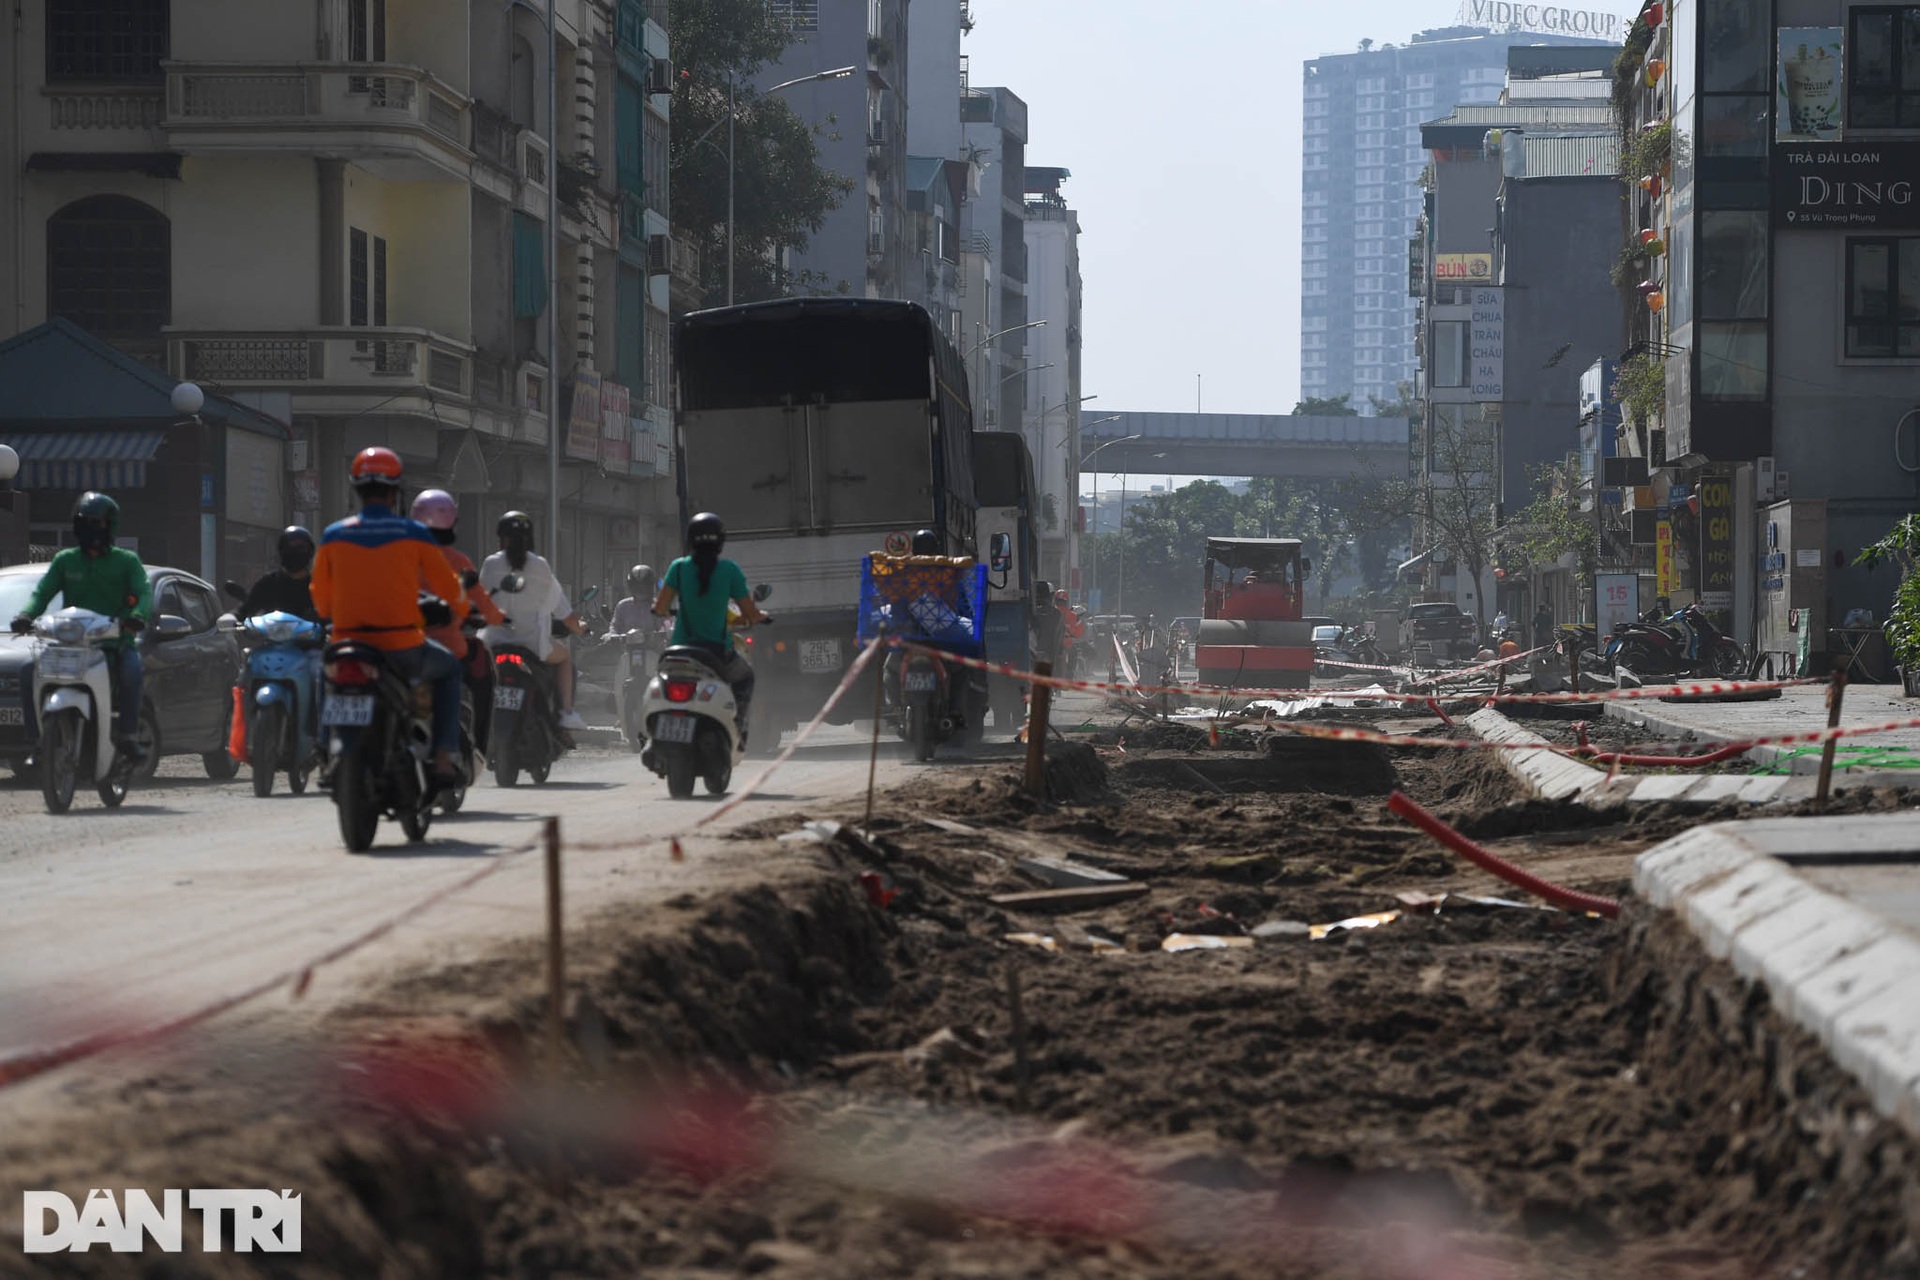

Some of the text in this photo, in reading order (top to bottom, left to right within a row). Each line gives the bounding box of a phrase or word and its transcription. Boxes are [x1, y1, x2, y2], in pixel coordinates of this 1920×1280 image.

[1542, 6, 1616, 36] GROUP
[1787, 151, 1880, 163] TRÀ ĐÀI LOAN
[1800, 176, 1912, 205] DING
[1436, 258, 1467, 277] BÚN
[1472, 384, 1500, 394] LONG
